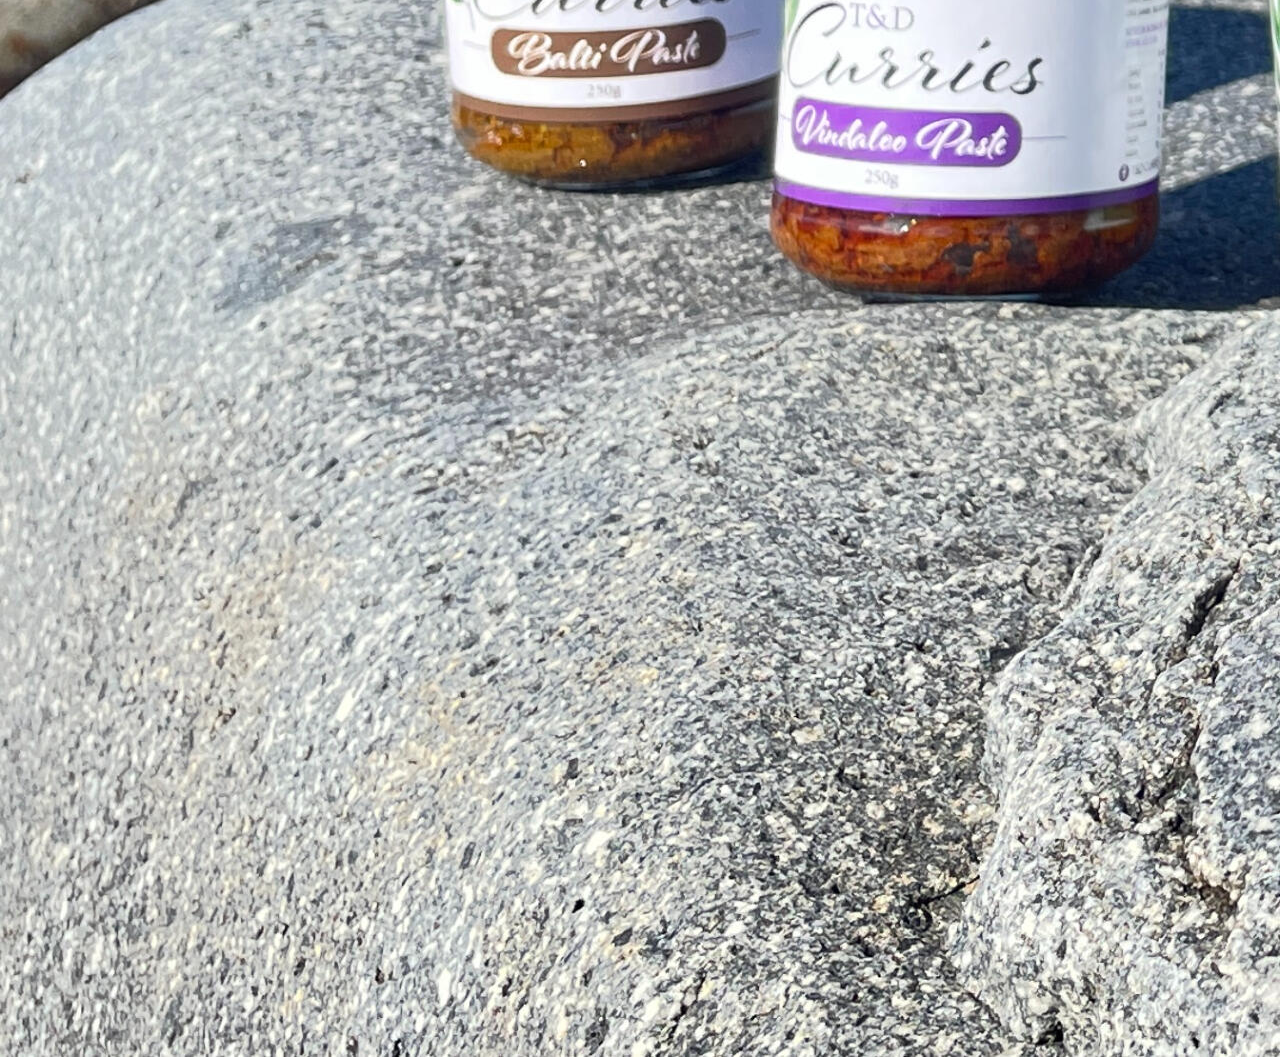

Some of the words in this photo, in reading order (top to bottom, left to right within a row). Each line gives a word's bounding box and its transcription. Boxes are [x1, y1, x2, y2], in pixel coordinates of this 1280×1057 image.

[850, 1, 915, 31] T&D
[506, 31, 607, 76] Balti
[609, 28, 701, 73] Paste
[787, 2, 1044, 95] Curries
[795, 105, 907, 154] Vindaloo
[915, 118, 1008, 160] Paste
[863, 170, 900, 190] 250g
